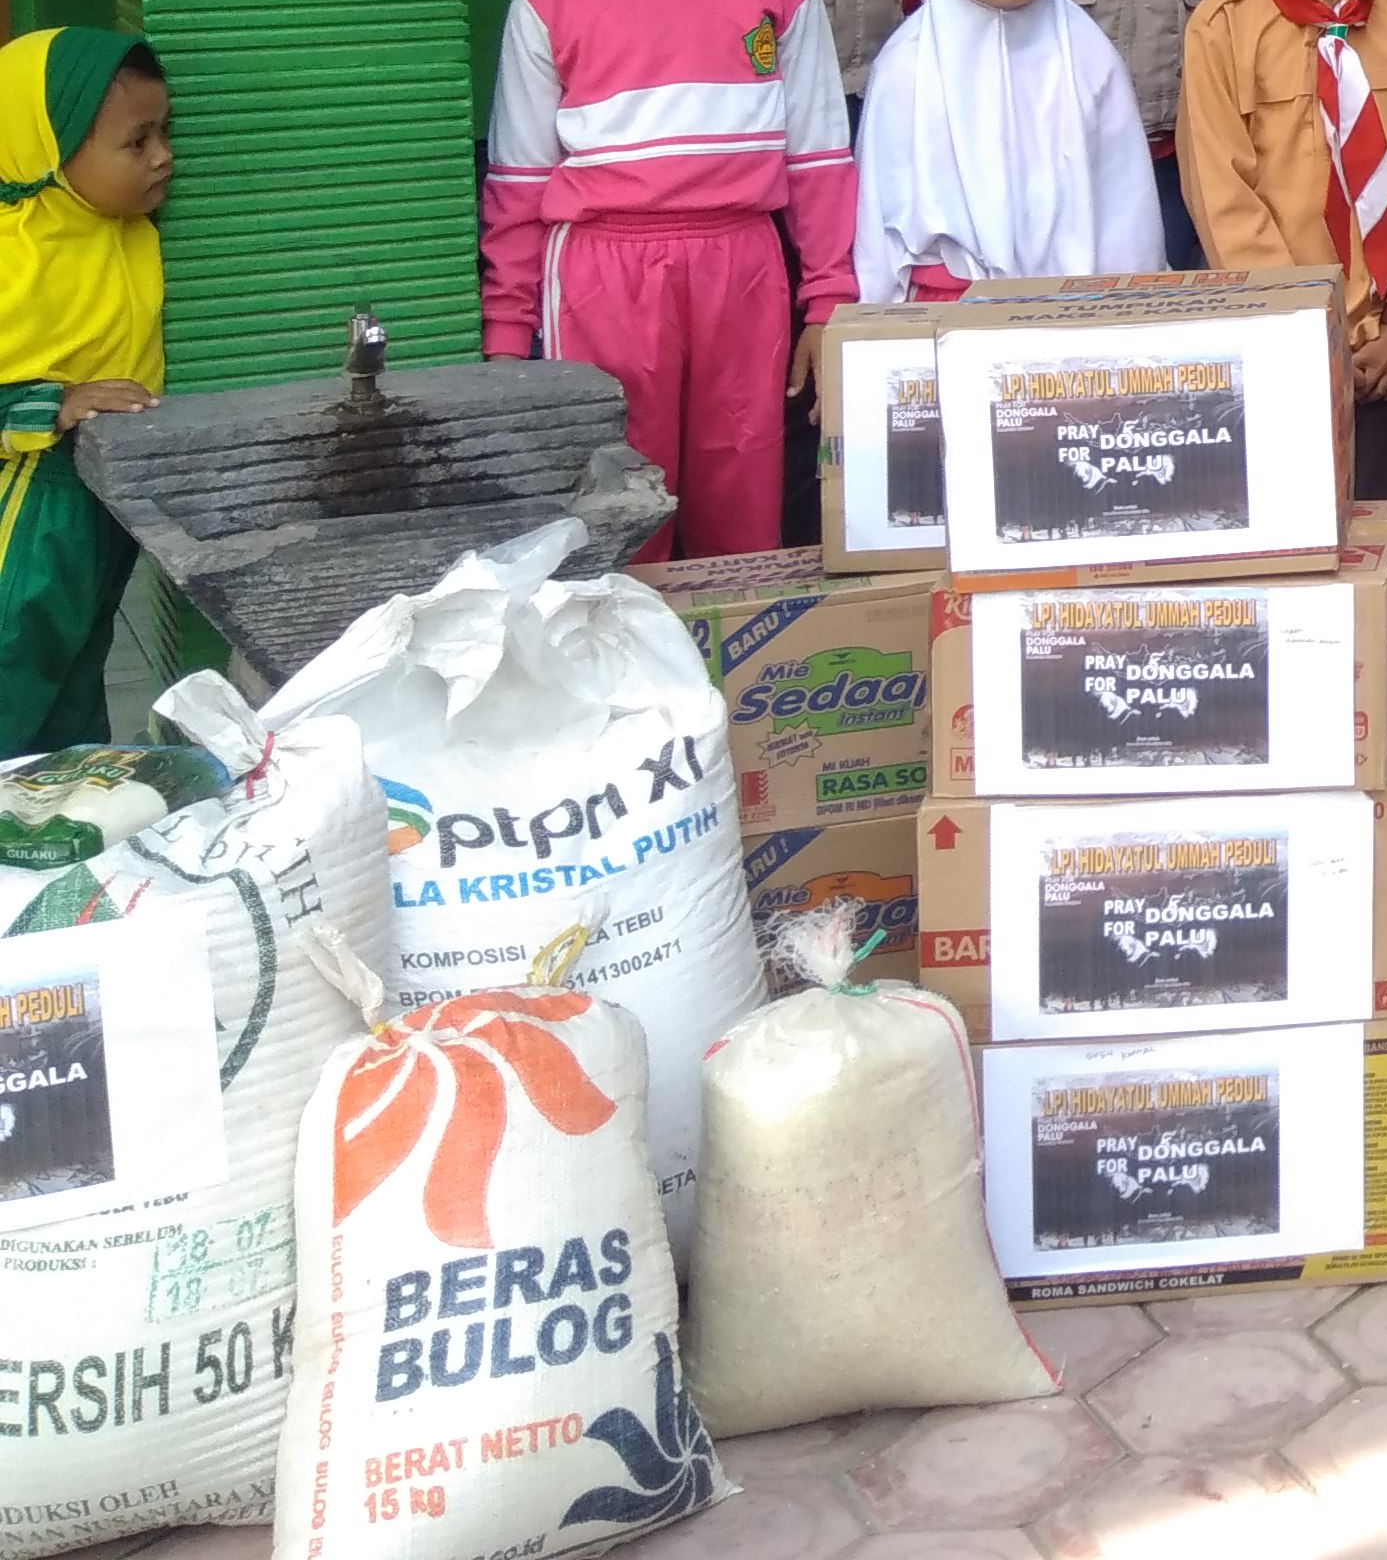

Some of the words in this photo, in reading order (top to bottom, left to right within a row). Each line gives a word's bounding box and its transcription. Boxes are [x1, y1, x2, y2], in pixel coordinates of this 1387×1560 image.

[1058, 296, 1227, 313] TUMPUKAN
[1150, 302, 1268, 316] KARTON
[1001, 373, 1027, 401] LPI
[1028, 368, 1114, 400] HIDAYATUL
[1117, 364, 1174, 396] UMMAH
[1178, 361, 1231, 392] PEDULI
[1057, 423, 1099, 441] PRAY
[1100, 427, 1231, 449] DONGGALA
[1058, 446, 1090, 462] FOR
[1101, 454, 1163, 473] PALU
[727, 616, 779, 661] BARU
[760, 661, 811, 683] Mie
[436, 782, 629, 868] ptpn
[636, 735, 704, 804] XI
[822, 771, 887, 796] RASA
[7, 848, 58, 861] GULAKU
[459, 856, 628, 903] KRISTAL
[632, 803, 720, 864] PUTIH
[401, 944, 527, 970] KOMPOSISI
[613, 906, 664, 937] TEBU
[16, 983, 85, 1026] PEDULI
[383, 1228, 633, 1333] BERAS
[1032, 1285, 1073, 1299] ROMA
[1078, 1279, 1156, 1296] SANDWICH
[1158, 1273, 1225, 1290] COKELAT
[193, 1321, 253, 1405] 50
[375, 1293, 634, 1403] BULOG
[365, 1437, 468, 1489] BERAT
[480, 1412, 584, 1464] NETTO
[99, 1480, 181, 1513] OLEH
[364, 1487, 400, 1524] 15
